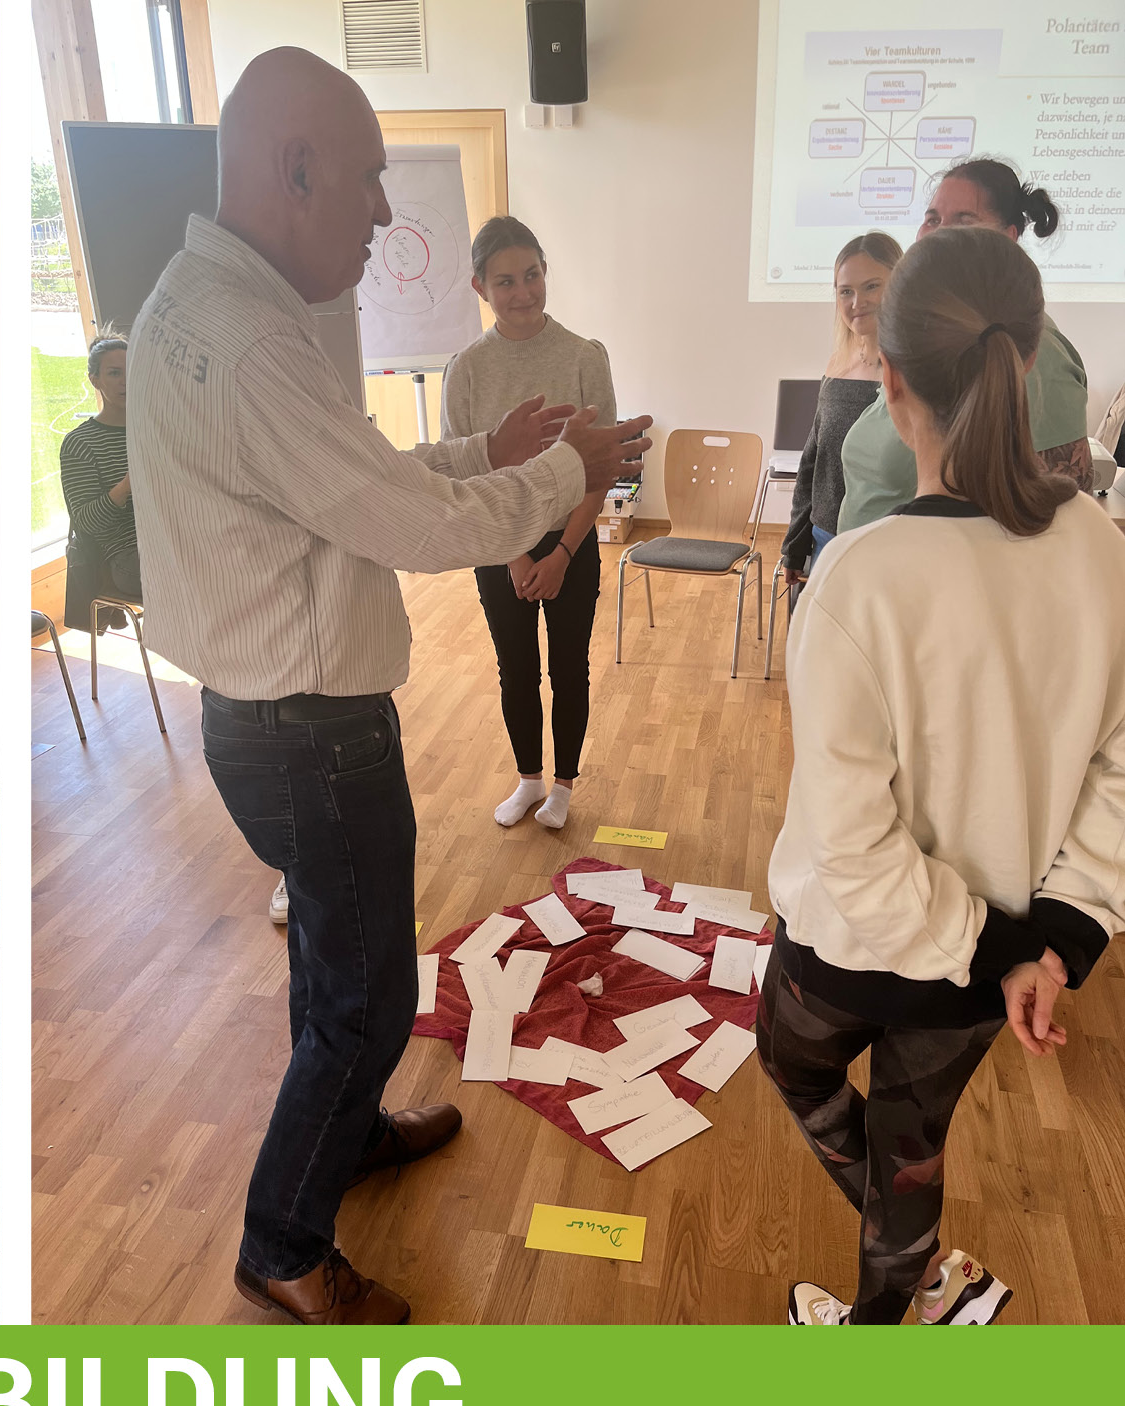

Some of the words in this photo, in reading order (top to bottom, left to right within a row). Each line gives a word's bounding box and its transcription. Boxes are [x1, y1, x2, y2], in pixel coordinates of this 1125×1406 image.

[1045, 17, 1120, 33] Polaritäten
[864, 46, 881, 56] Vier
[884, 45, 941, 56] Teamkulturen
[1072, 39, 1110, 54] Team
[1040, 93, 1060, 105] Wir
[1063, 92, 1109, 108] bewegen
[1037, 110, 1100, 124] dazwischen,
[1103, 111, 1113, 125] je
[1035, 128, 1109, 141] Persönlichkeit
[1030, 170, 1050, 181] Wie
[1052, 170, 1091, 181] erleben
[1047, 187, 1102, 198] zubildende
[1106, 187, 1122, 198] die
[1074, 205, 1085, 215] in
[1076, 222, 1095, 231] mit
[1096, 221, 1117, 231] dir?
[612, 831, 653, 844] Wandel
[587, 1089, 643, 1114] Sympathie
[565, 1220, 629, 1248] Dauer
